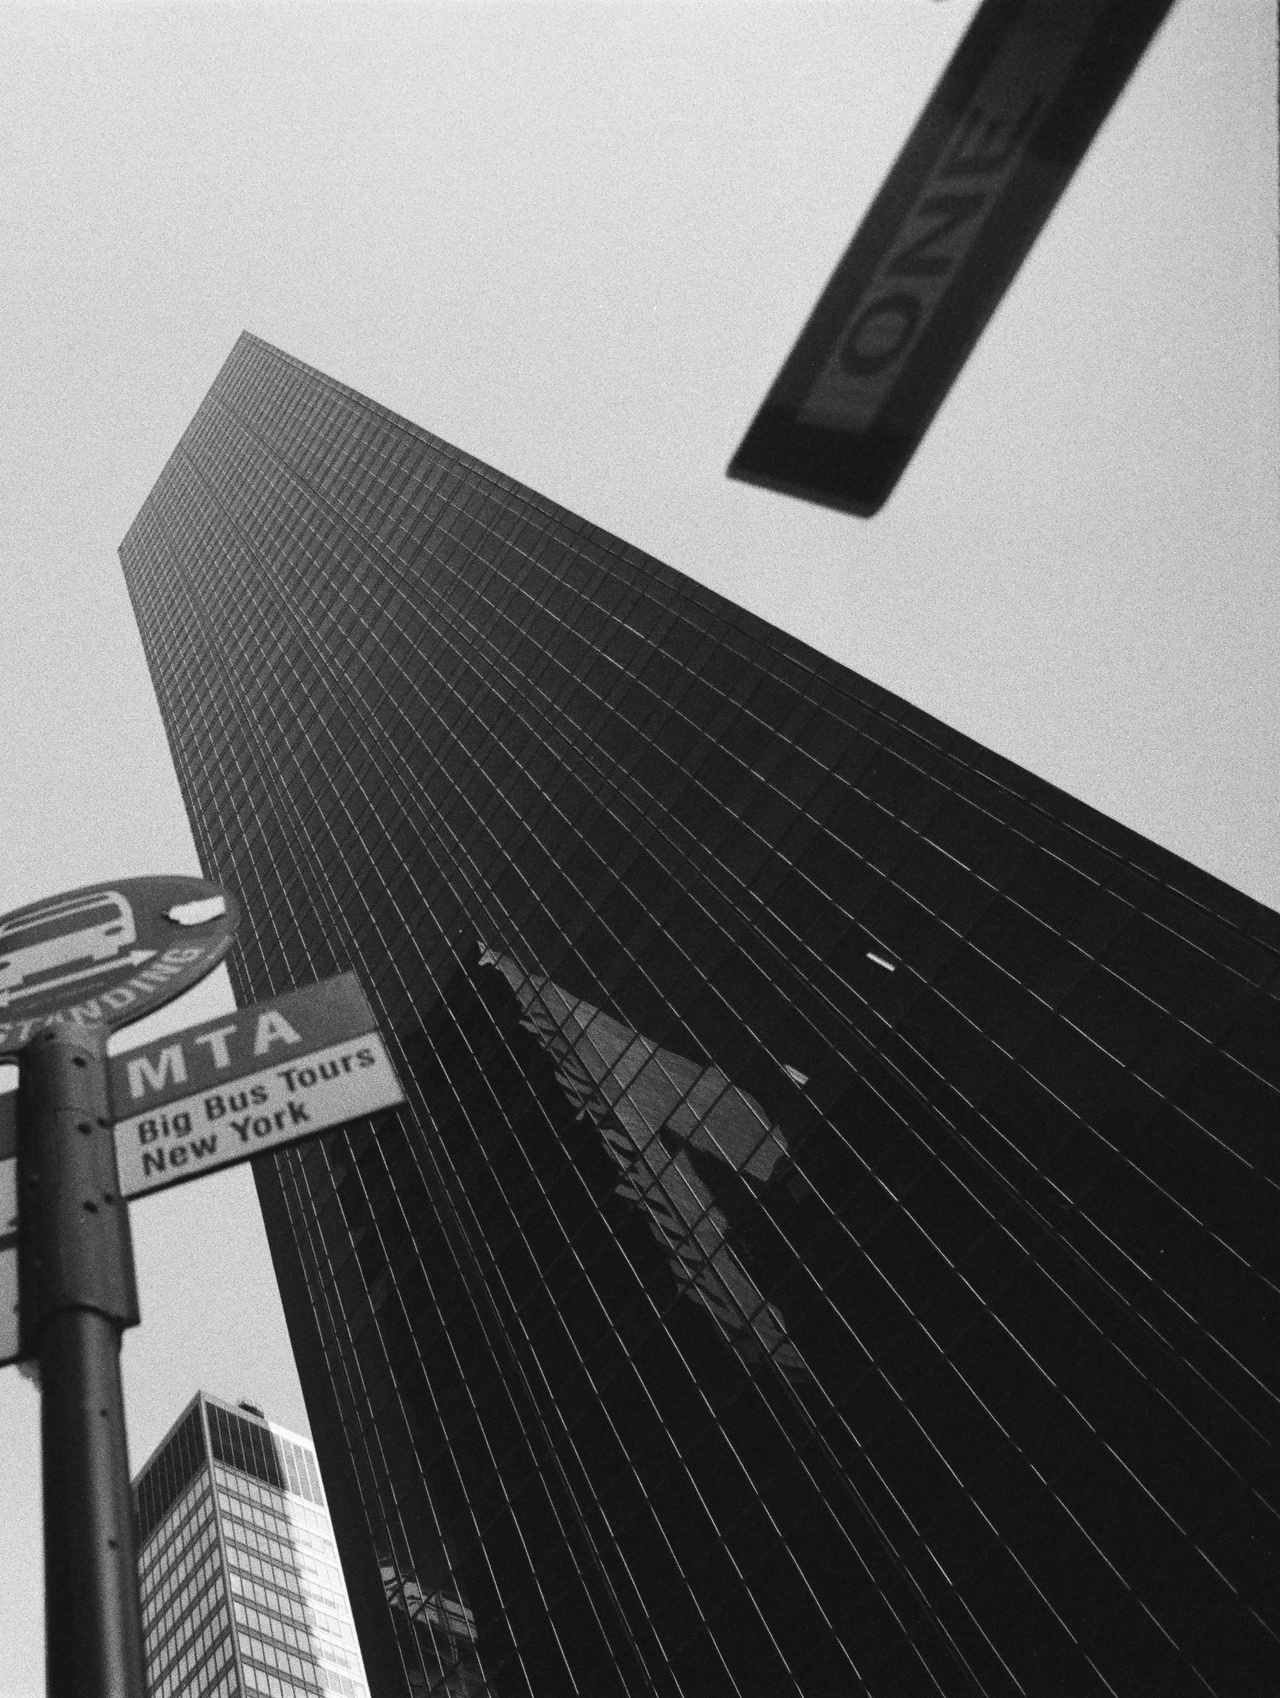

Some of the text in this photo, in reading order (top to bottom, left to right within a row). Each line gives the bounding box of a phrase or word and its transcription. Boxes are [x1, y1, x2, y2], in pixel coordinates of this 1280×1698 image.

[839, 91, 1046, 377] ONE
[126, 1010, 302, 1098] MTA
[136, 1048, 376, 1146] Big Bus Tours
[141, 1102, 310, 1177] New York
